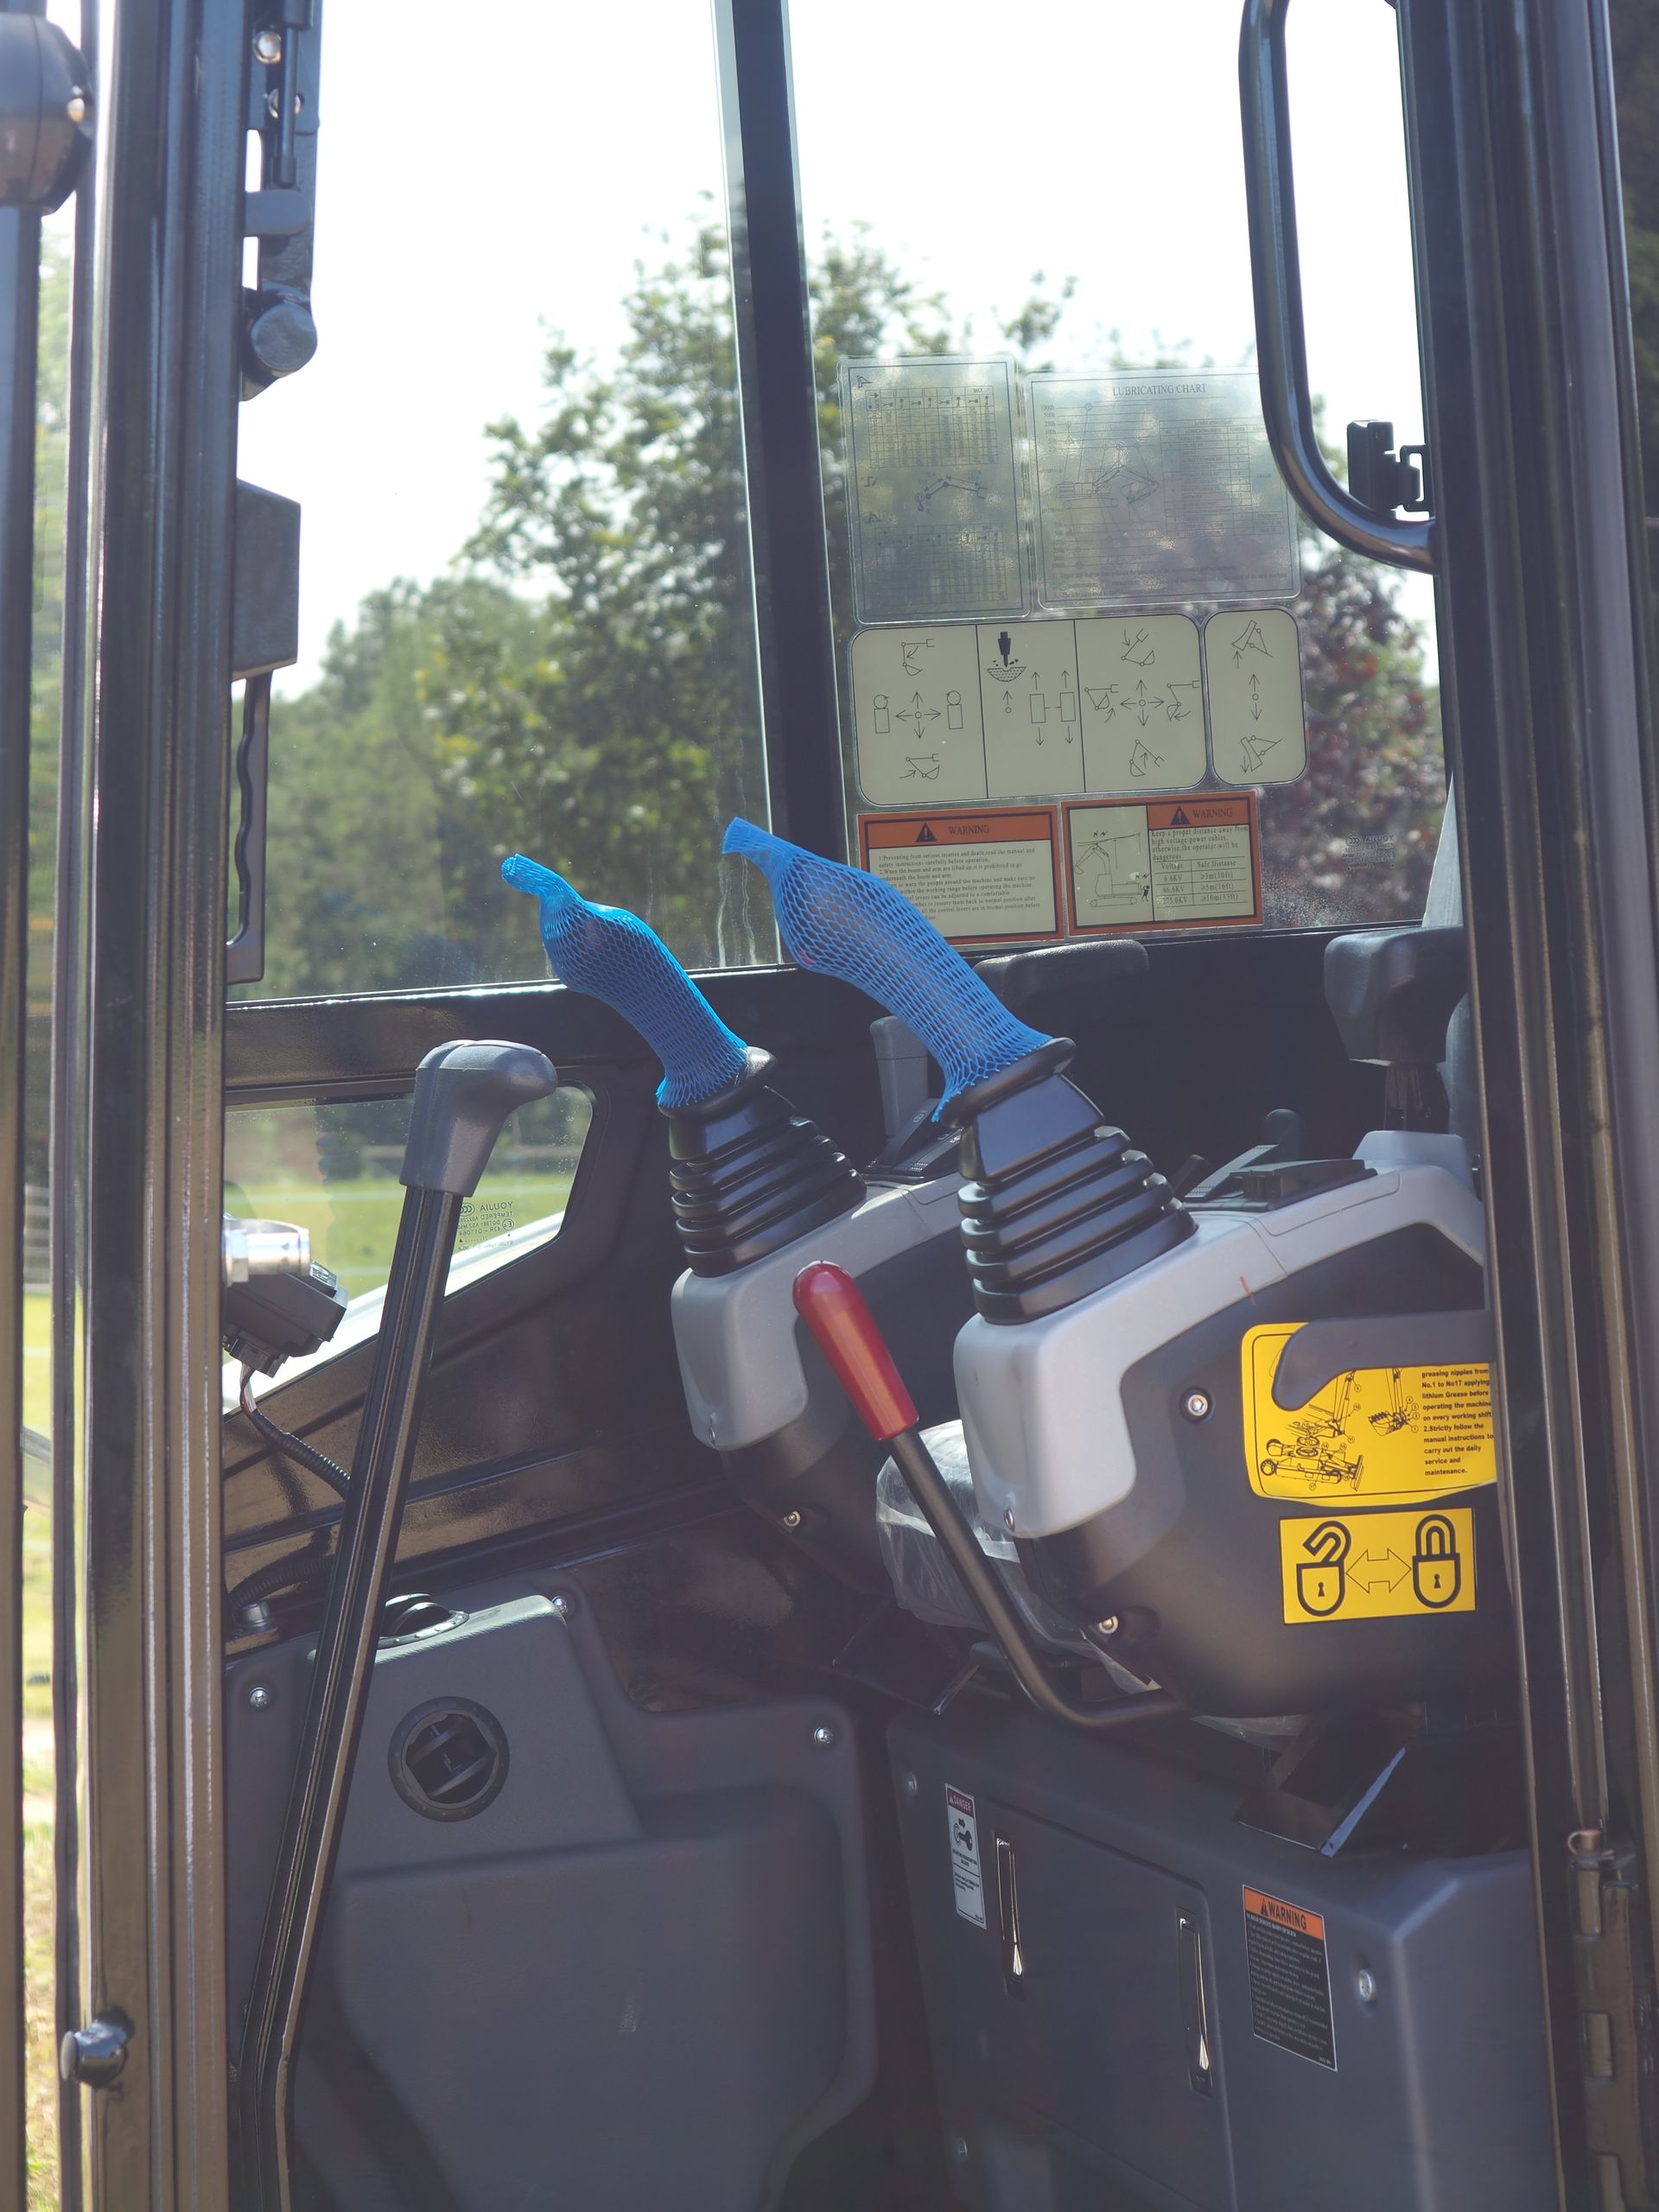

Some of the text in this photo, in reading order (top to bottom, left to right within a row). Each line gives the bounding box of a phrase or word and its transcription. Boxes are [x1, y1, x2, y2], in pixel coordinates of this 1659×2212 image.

[1113, 383, 1206, 396] LUBRICATING CHART
[1192, 808, 1233, 819] WARNING
[949, 824, 989, 836] WARNING
[1152, 837, 1164, 846] high
[1192, 842, 1216, 851] operator
[984, 861, 1008, 870] prohibited
[927, 879, 943, 887] people
[979, 883, 1001, 892] operating
[1421, 1370, 1449, 1379] greasing
[1422, 1402, 1452, 1411] operating
[953, 1795, 972, 1812] DANGER
[1268, 1901, 1307, 1929] WARNING
